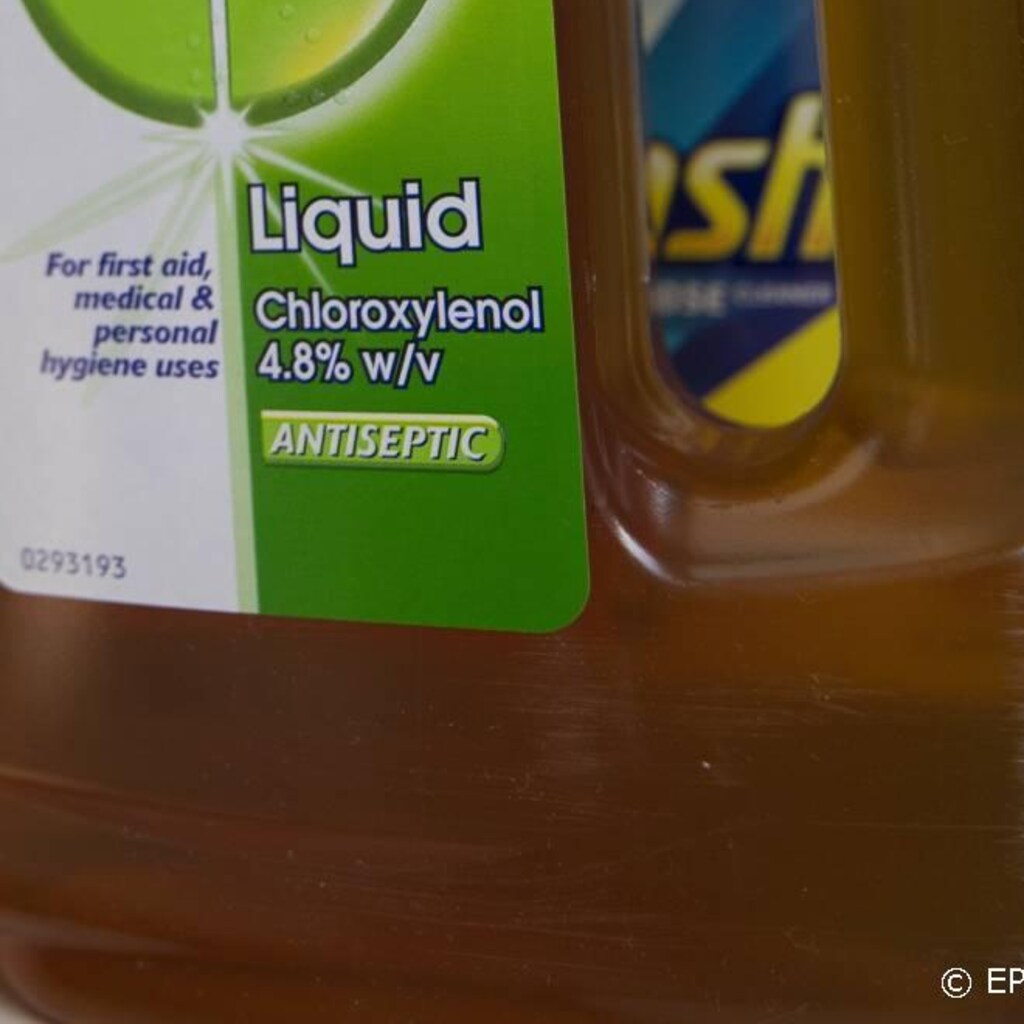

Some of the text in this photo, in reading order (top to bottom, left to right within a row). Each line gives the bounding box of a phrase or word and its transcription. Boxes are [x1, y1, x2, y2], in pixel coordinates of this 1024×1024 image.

[248, 177, 483, 267] Liquid
[45, 250, 212, 282] For first aid,
[74, 285, 215, 311] medical &
[254, 286, 544, 340] Chloroxylenol
[92, 318, 219, 350] personal
[40, 348, 221, 382] hygiene uses
[257, 339, 444, 389] 4.8% w/v
[270, 422, 489, 462] ANTISEPTIC
[20, 546, 127, 580] 0293193
